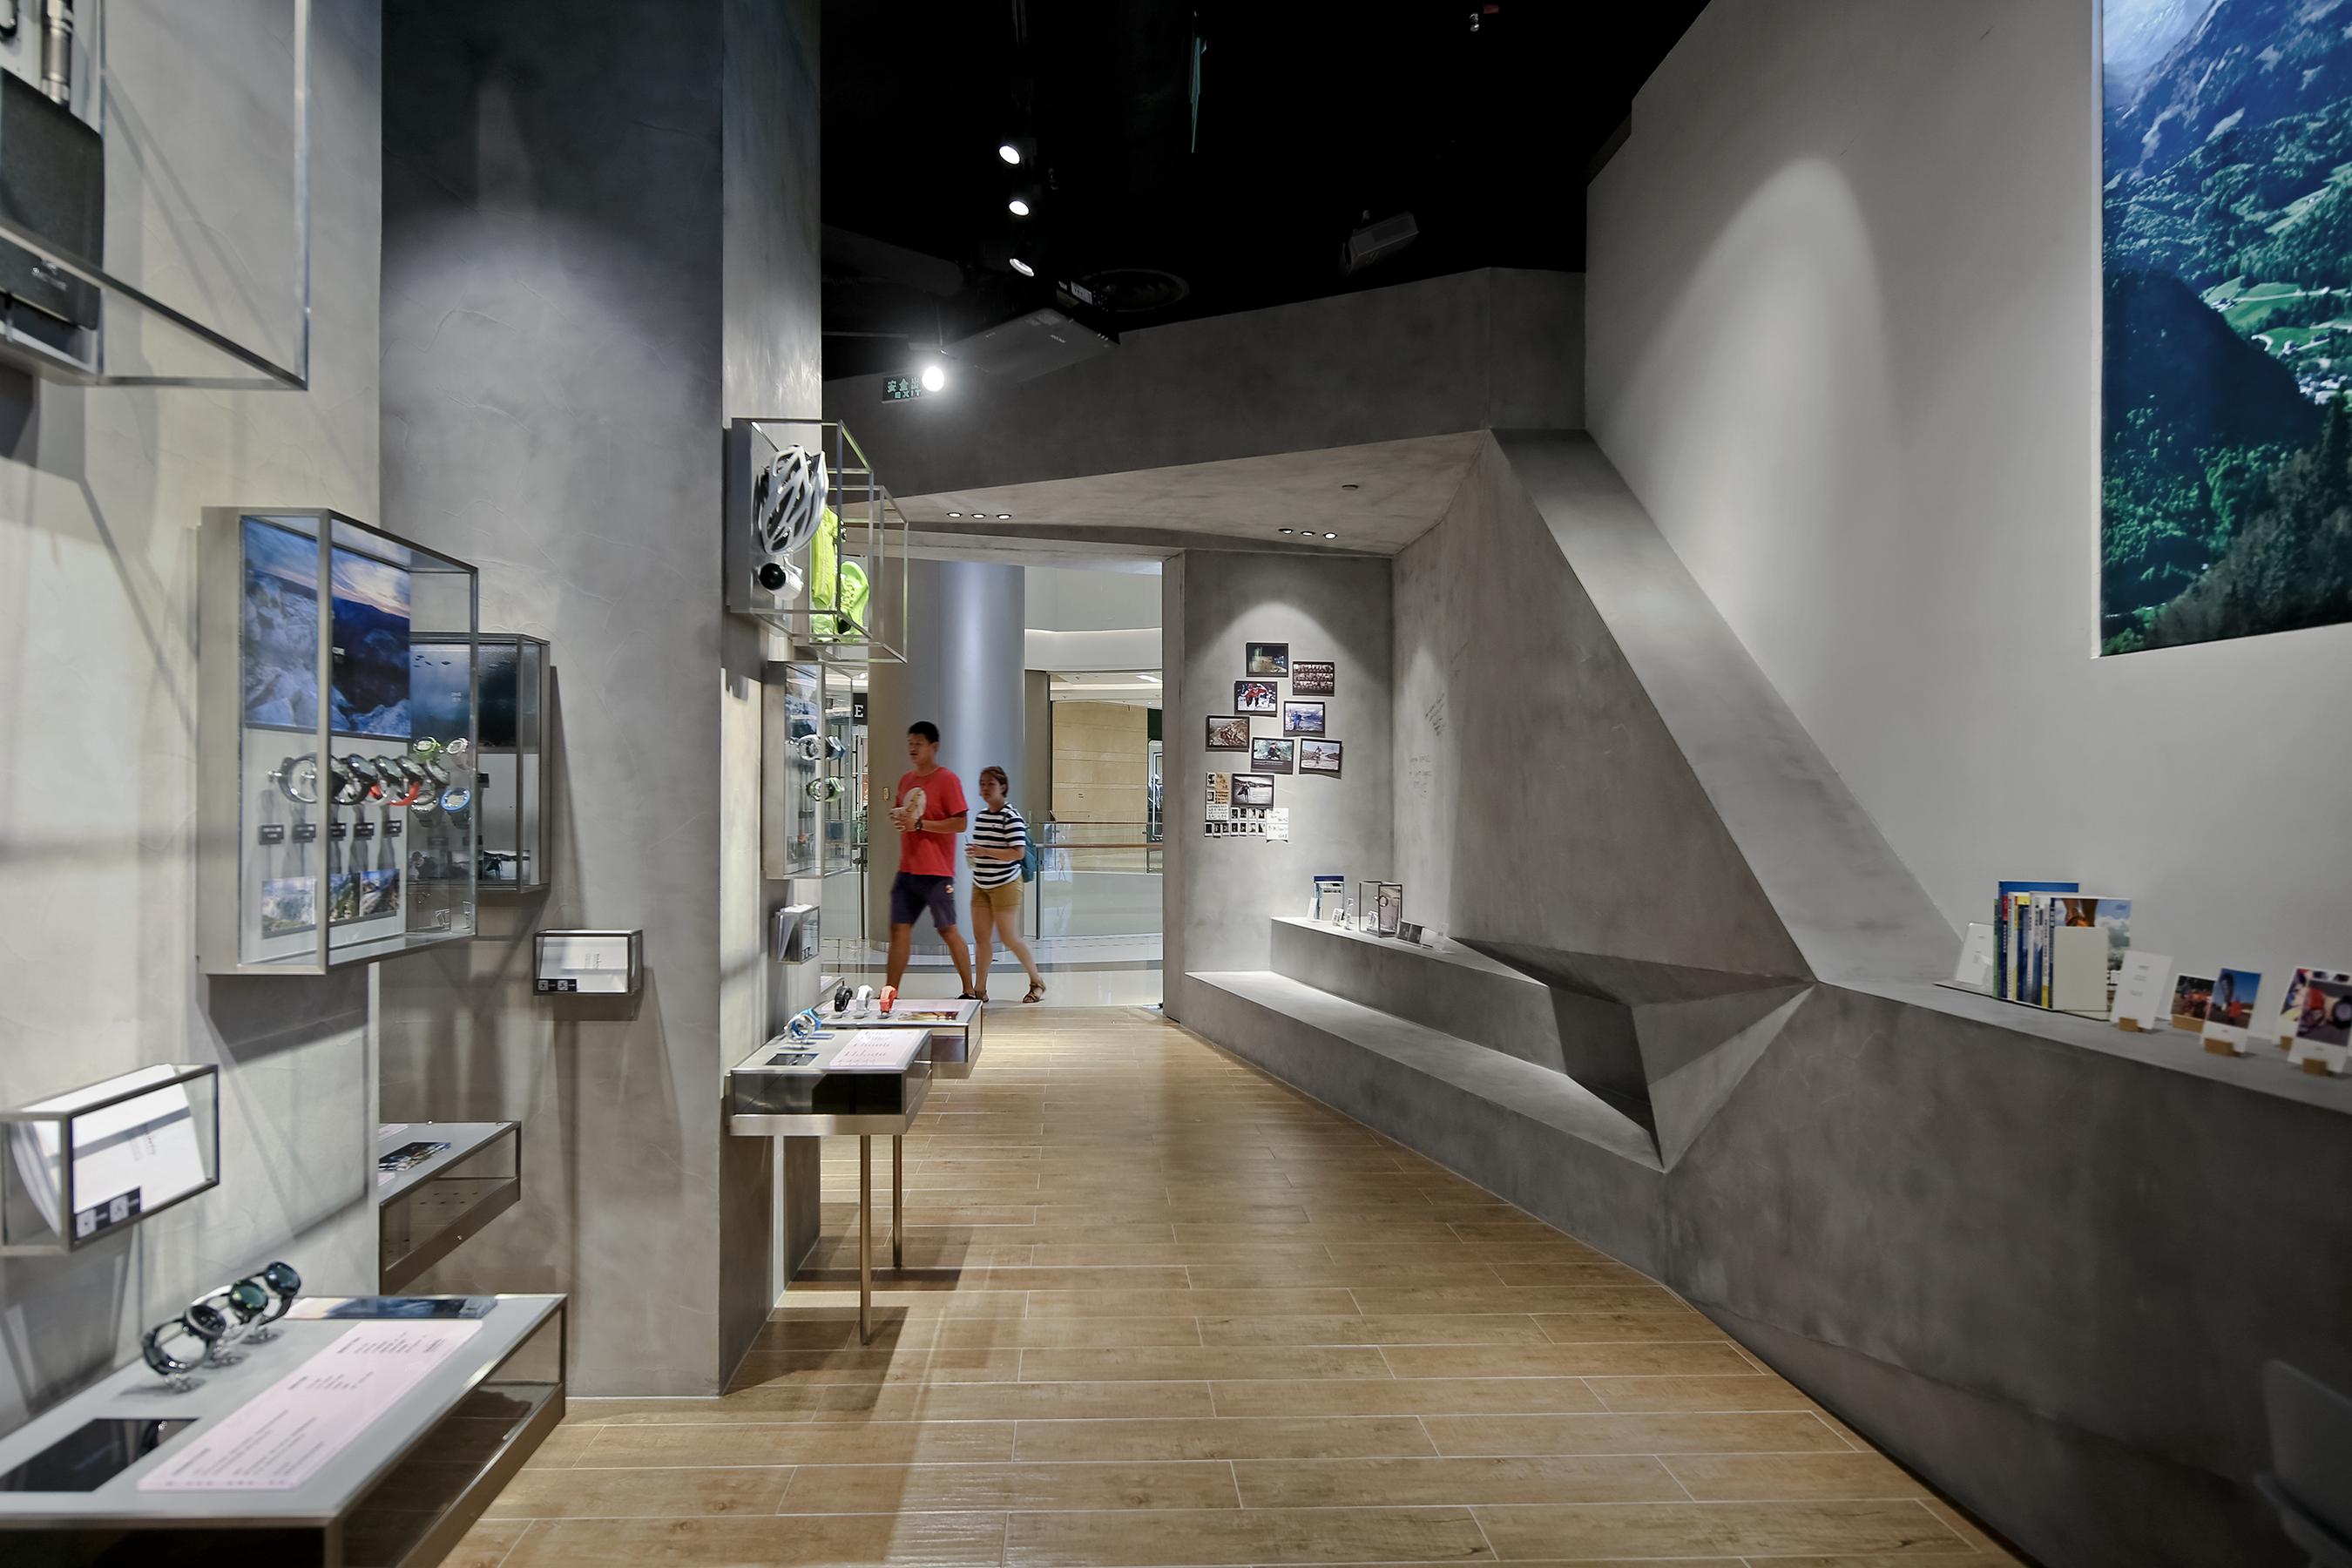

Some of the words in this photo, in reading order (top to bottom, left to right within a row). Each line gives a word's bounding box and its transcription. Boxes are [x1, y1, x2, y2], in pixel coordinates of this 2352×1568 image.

[887, 376, 922, 393] 安全出
[895, 389, 921, 399] EXIT
